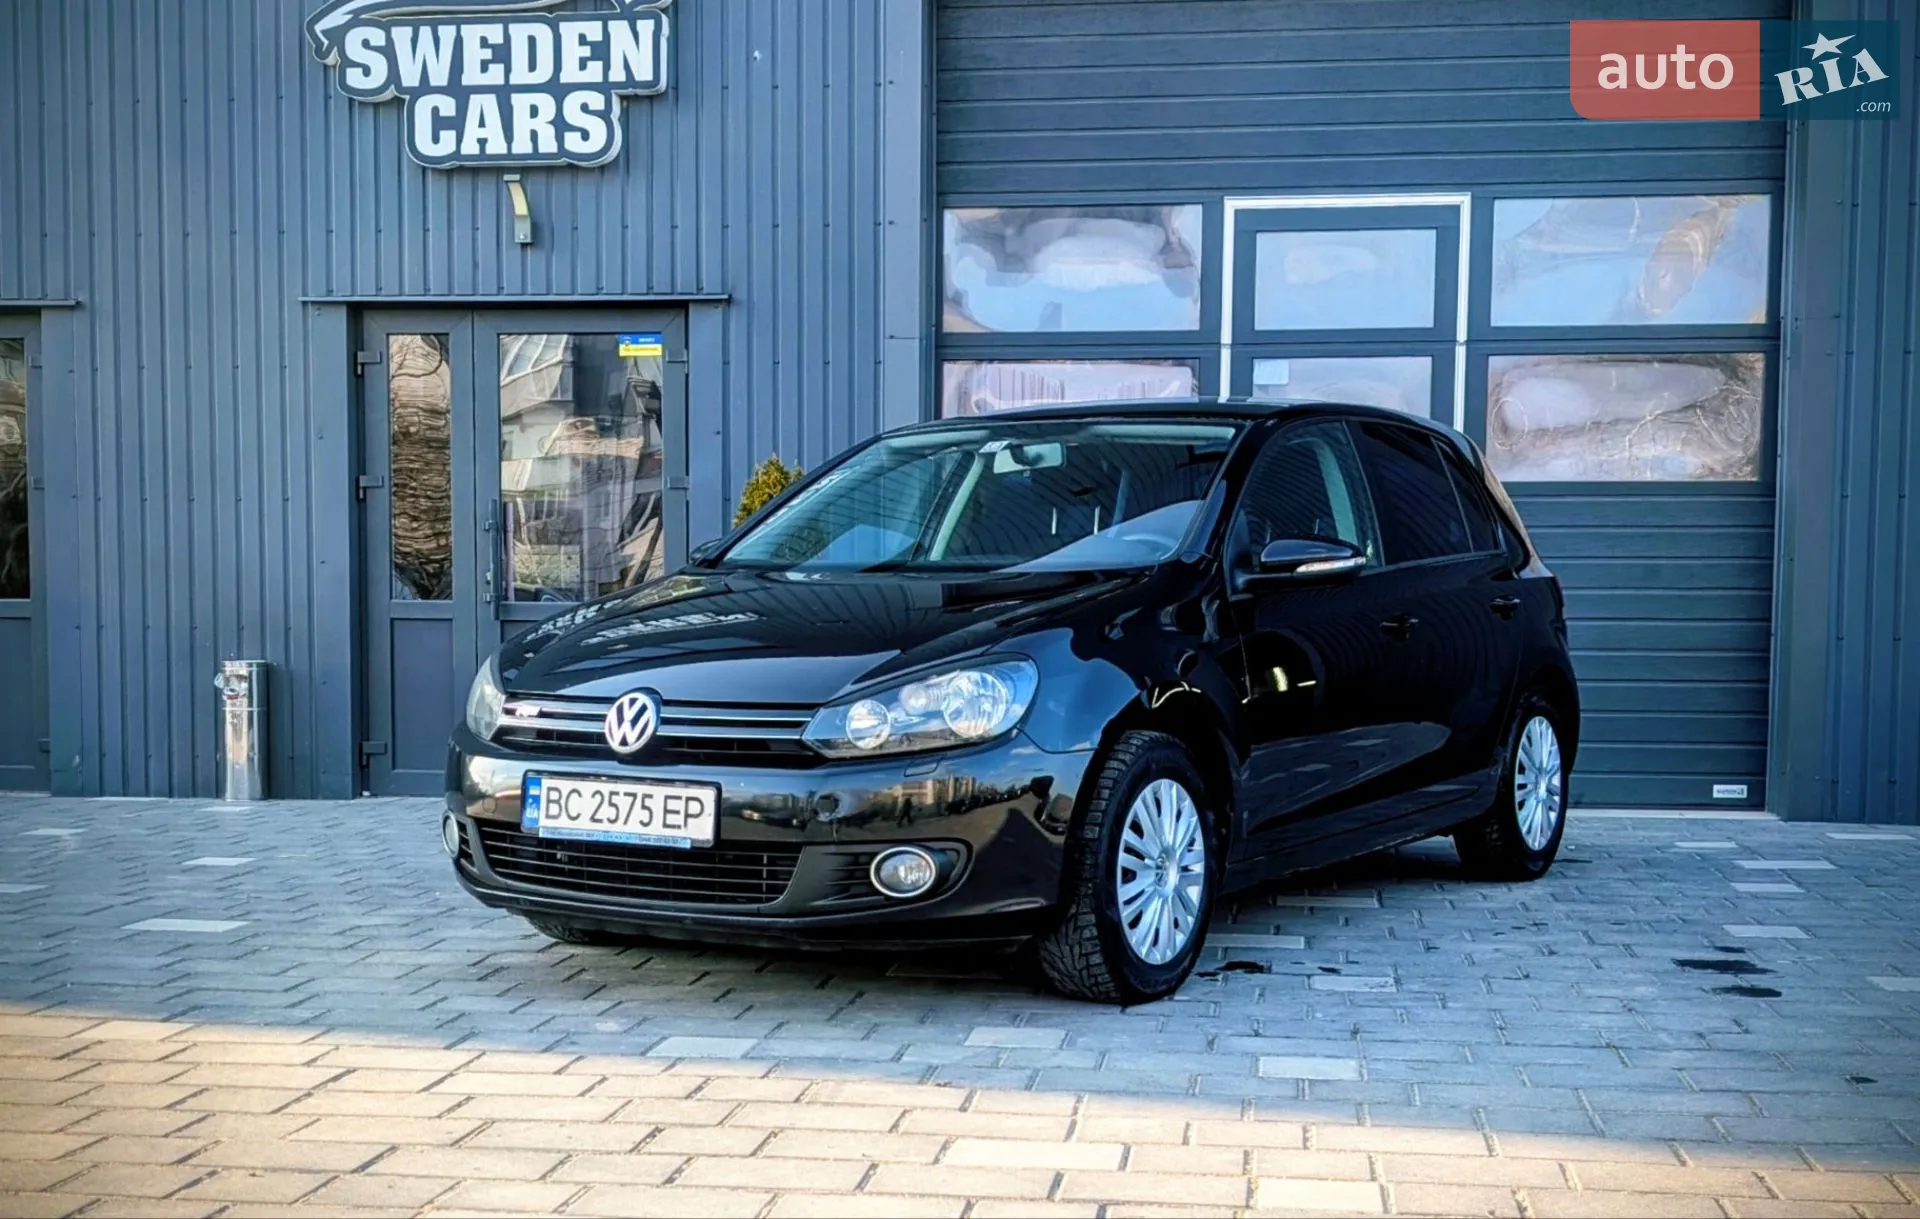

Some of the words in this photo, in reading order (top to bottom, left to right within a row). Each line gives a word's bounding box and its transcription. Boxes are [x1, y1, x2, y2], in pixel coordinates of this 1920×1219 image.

[344, 19, 655, 90] SWEDEN
[414, 91, 607, 157] CARS
[545, 786, 582, 821] BC
[589, 790, 653, 828] 2575
[662, 795, 704, 829] EP
